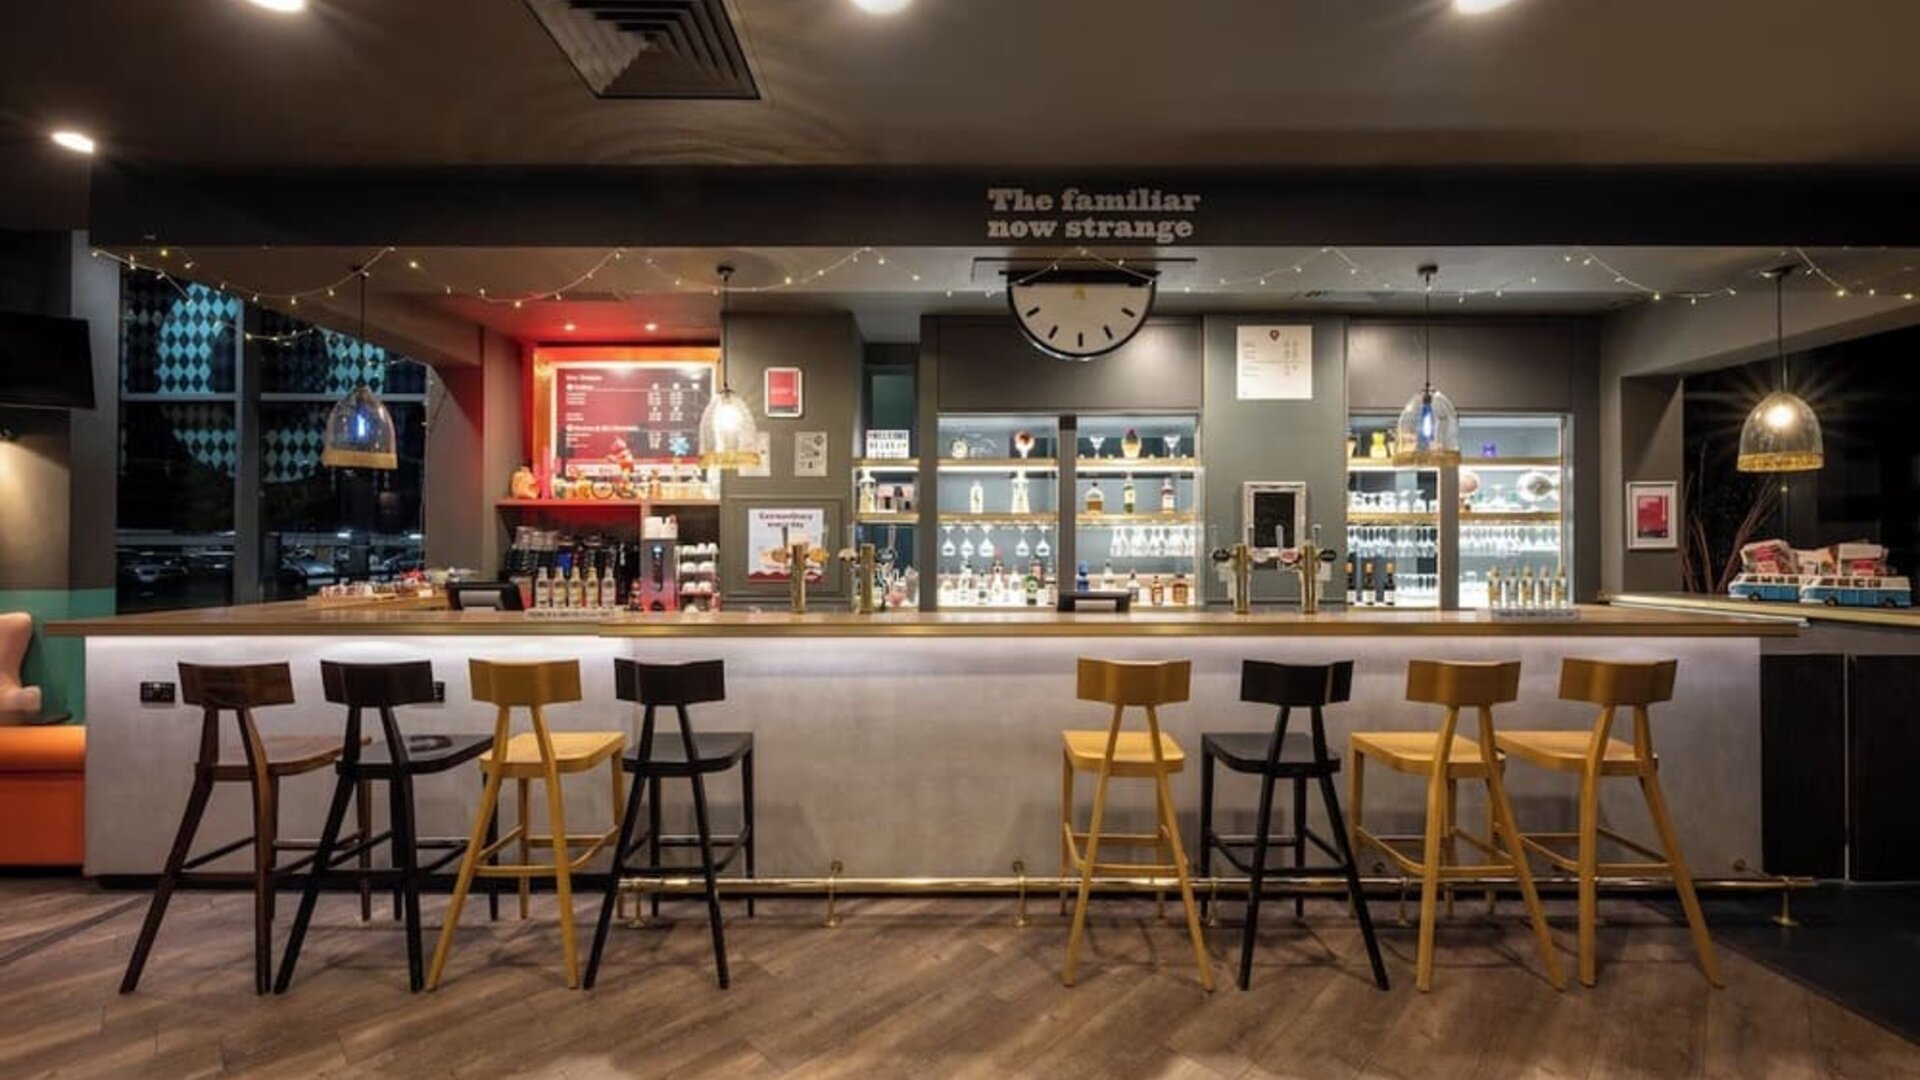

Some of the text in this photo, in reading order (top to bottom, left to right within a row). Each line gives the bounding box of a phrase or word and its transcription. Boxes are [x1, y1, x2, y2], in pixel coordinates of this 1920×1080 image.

[987, 188, 1200, 212] The familiar
[987, 217, 1193, 244] now strange
